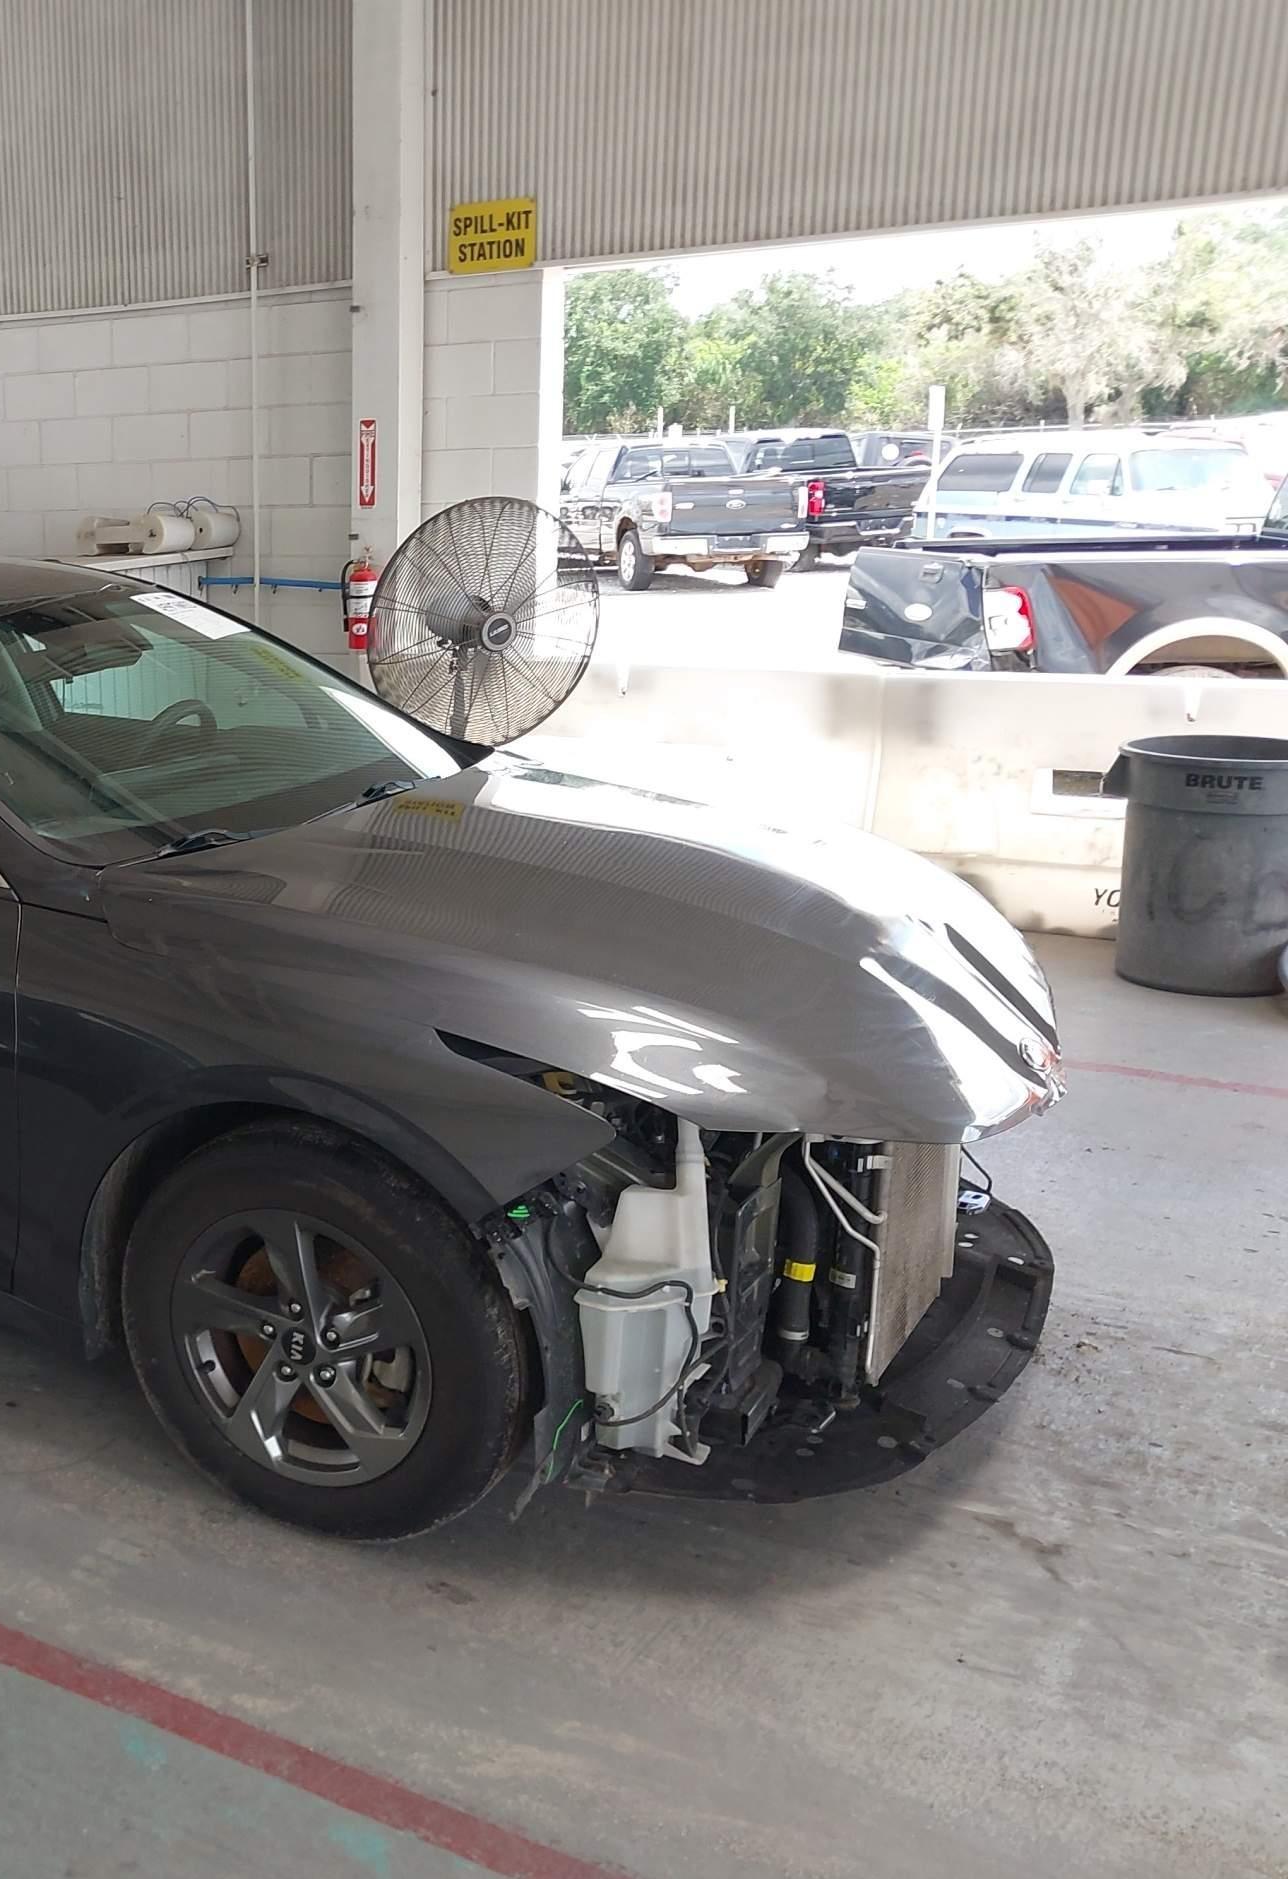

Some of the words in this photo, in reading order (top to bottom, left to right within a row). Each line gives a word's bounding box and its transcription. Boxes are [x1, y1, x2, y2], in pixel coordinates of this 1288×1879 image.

[453, 209, 532, 237] SPILL-KIT
[458, 237, 525, 263] STATION
[1185, 773, 1265, 791] BRUTE
[291, 1331, 304, 1361] KIA
